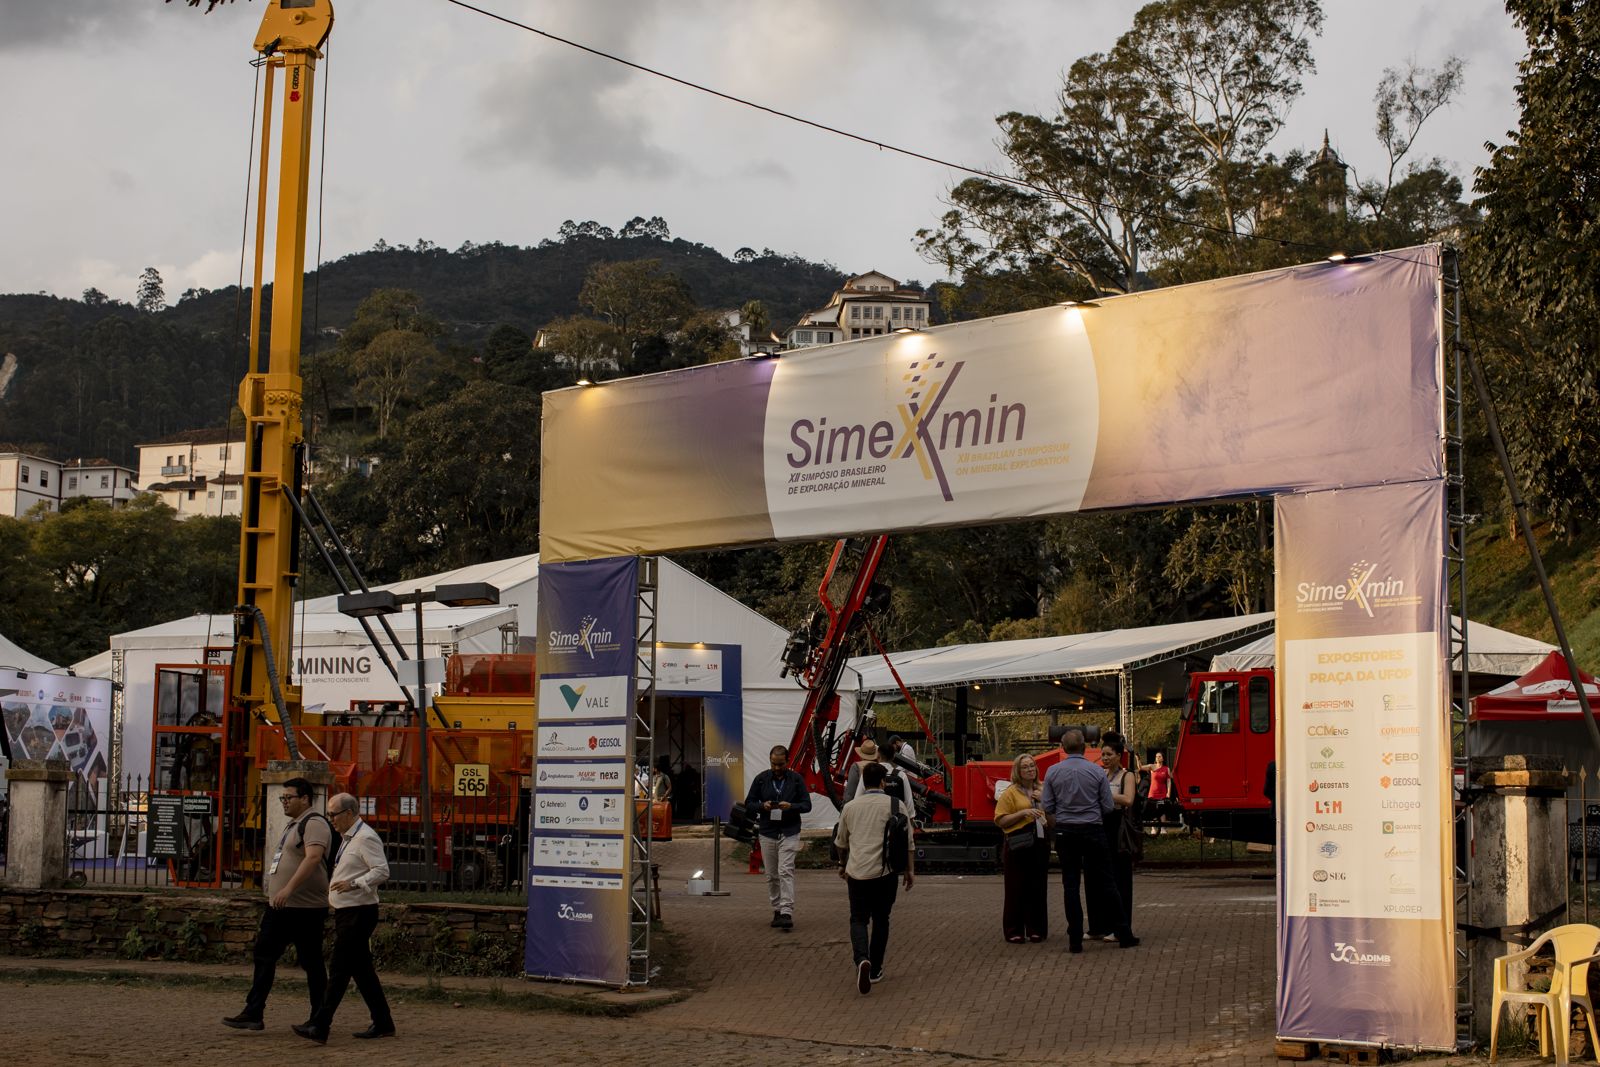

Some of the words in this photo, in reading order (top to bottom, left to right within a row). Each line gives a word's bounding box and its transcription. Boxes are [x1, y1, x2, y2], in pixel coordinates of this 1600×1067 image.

[971, 448, 1015, 462] BRAZILIAN
[1017, 443, 1070, 458] SYMPOSIUM
[955, 467, 970, 476] ON
[971, 462, 1008, 475] MINERAL
[1010, 456, 1069, 472] EXPLORATION
[801, 468, 839, 482] SIMPÓSIO
[840, 464, 886, 478] BRASILEIRO
[788, 486, 798, 495] DE
[799, 480, 849, 495] EXPLORAÇÃO
[851, 476, 886, 489] MINERAL
[1317, 649, 1405, 665] EXPOSITORES
[298, 656, 371, 674] MINING
[1309, 671, 1353, 686] PRAÇA
[1356, 671, 1376, 682] DA
[586, 697, 608, 708] VALE
[598, 738, 621, 748] GEOSOL
[462, 768, 482, 776] GSL
[600, 771, 619, 780] nexa
[458, 778, 485, 792] 565
[1393, 778, 1421, 786] GEOSOL
[1330, 872, 1346, 880] SEG
[1384, 905, 1422, 913] XPLORER
[1360, 954, 1391, 962] ADIMB
